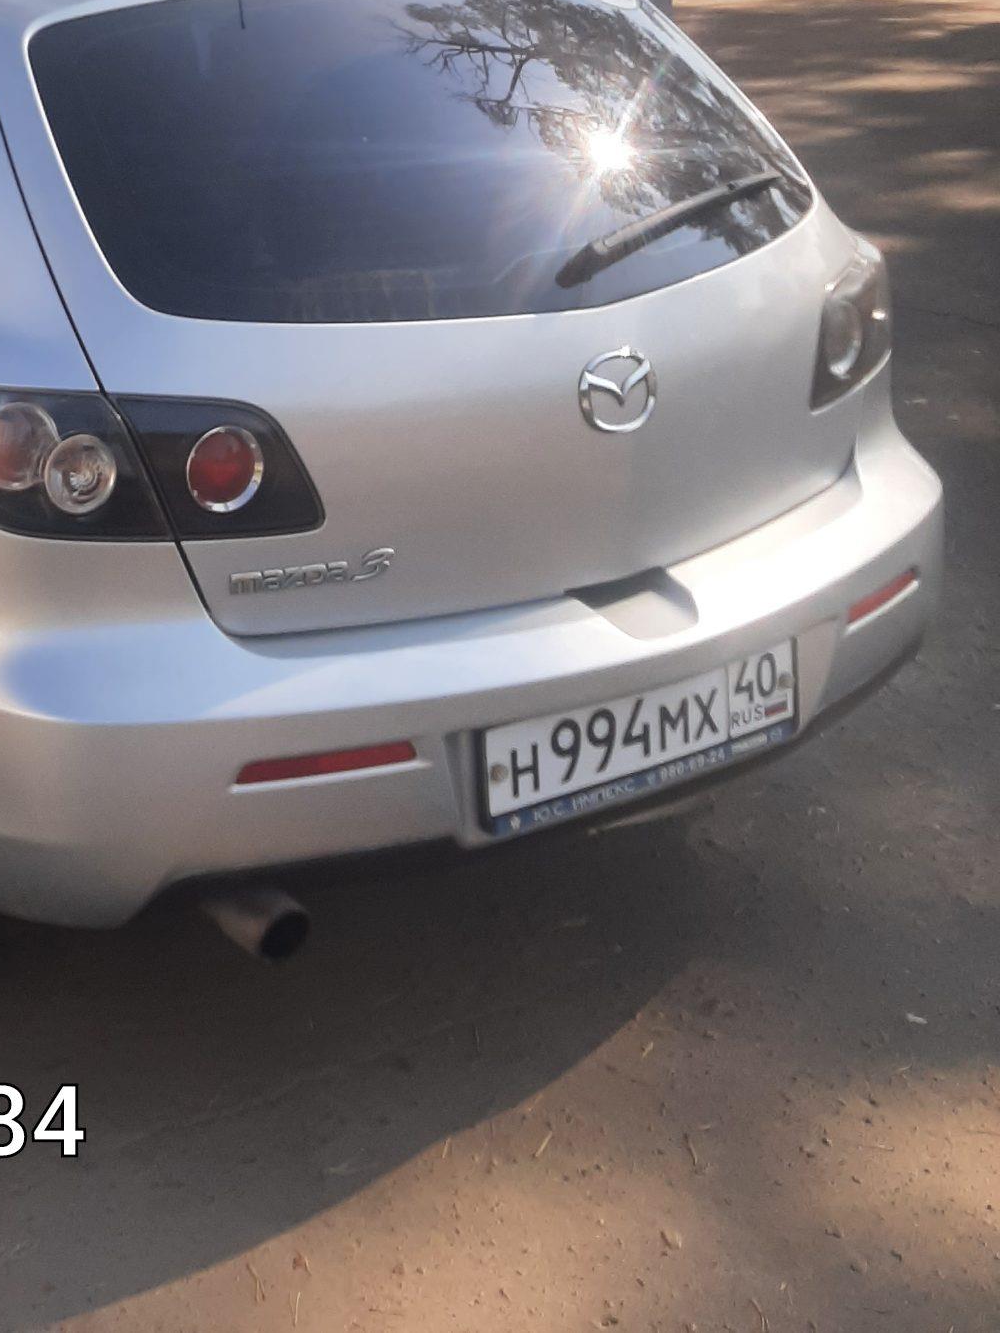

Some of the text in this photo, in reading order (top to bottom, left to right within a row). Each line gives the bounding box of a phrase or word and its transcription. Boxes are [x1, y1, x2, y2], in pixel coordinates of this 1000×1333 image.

[509, 652, 778, 799] Н994МХ 40
[730, 703, 764, 730] RUS
